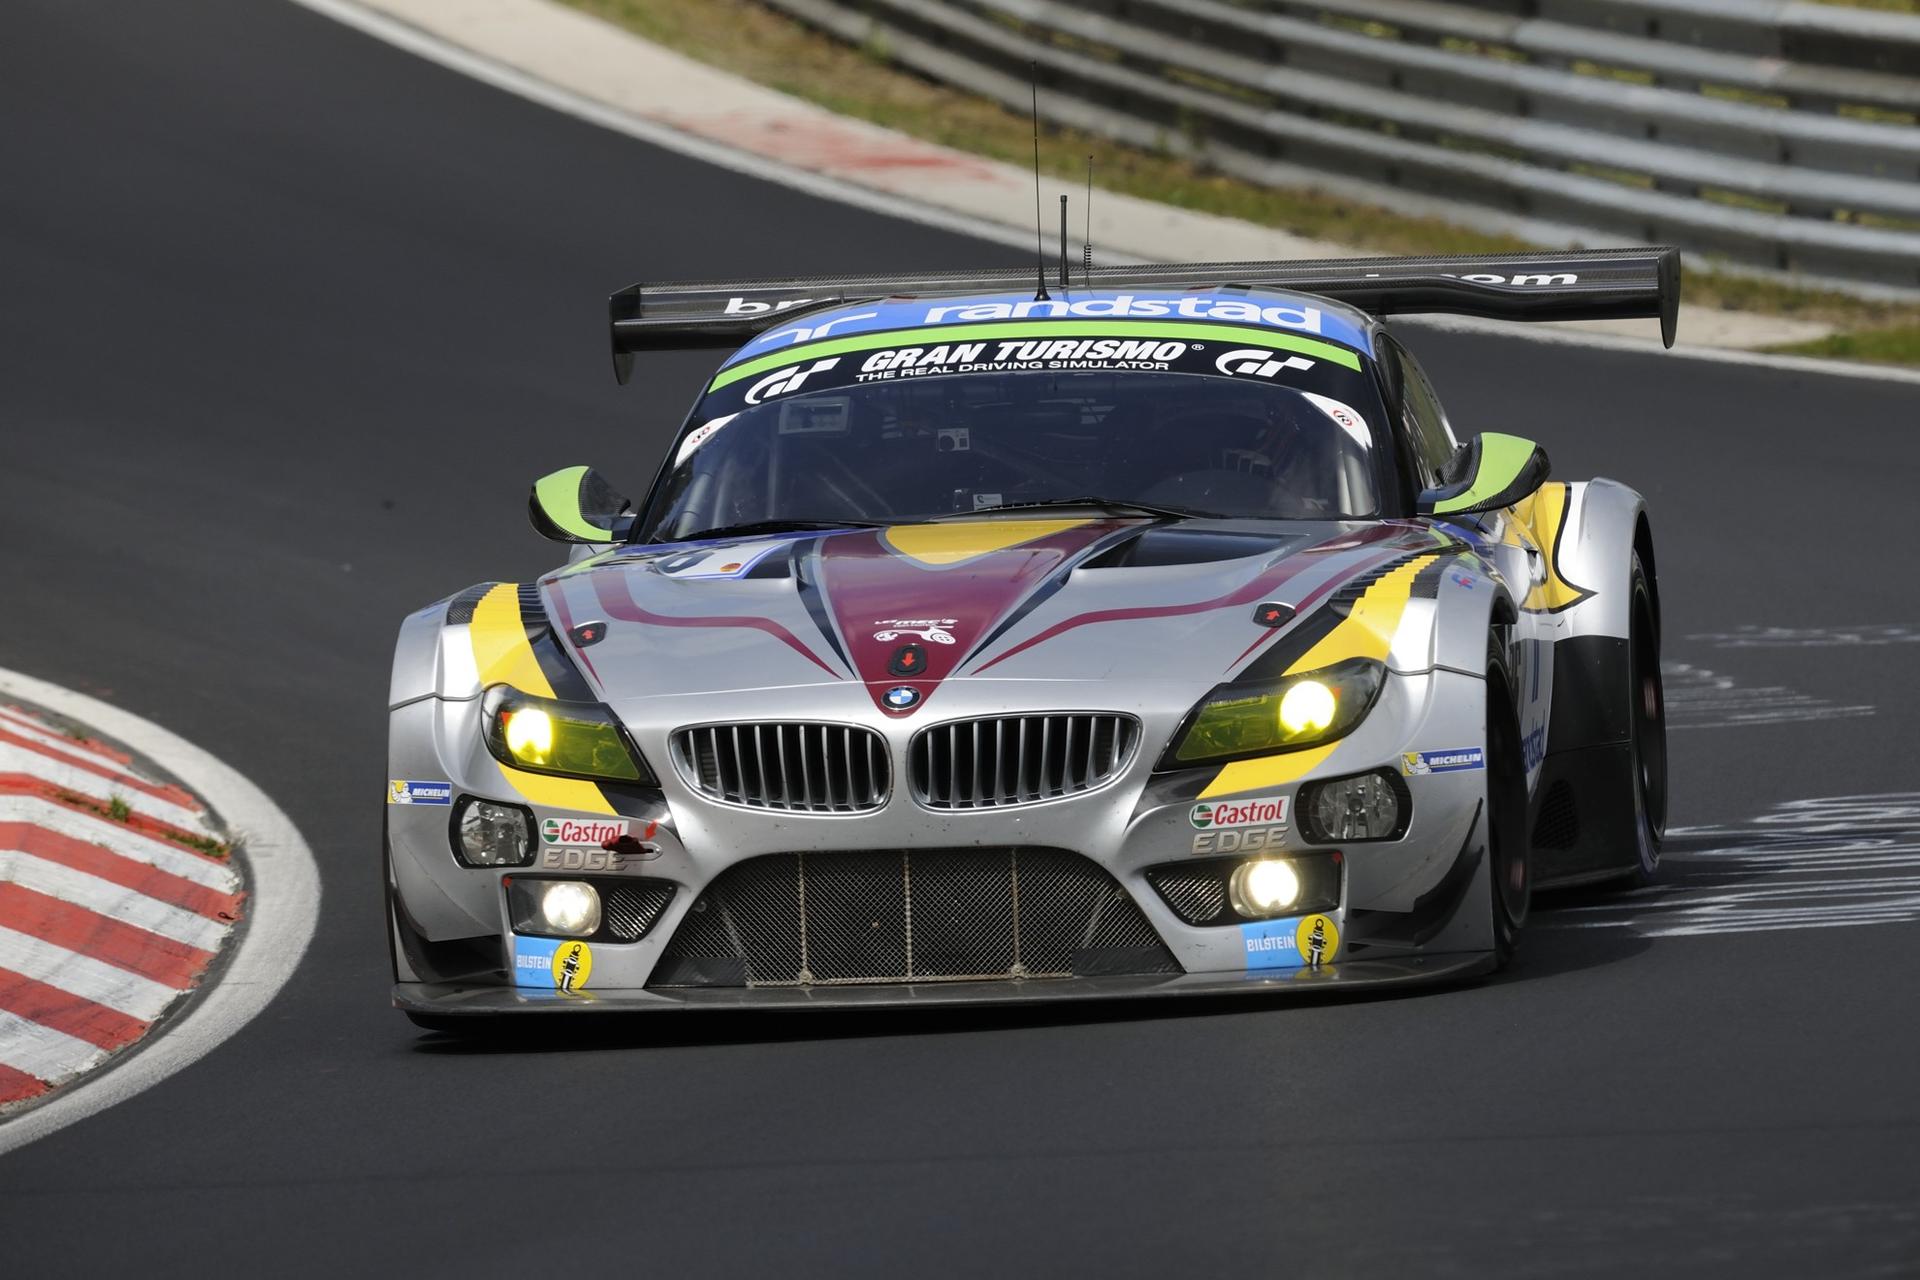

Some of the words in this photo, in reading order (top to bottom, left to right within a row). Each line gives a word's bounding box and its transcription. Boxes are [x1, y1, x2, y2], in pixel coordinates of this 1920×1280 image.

[924, 295, 1322, 334] randstad
[860, 343, 987, 373] GRAN
[994, 340, 1187, 361] TURISMO
[856, 370, 896, 382] THE
[900, 365, 954, 377] REAL
[958, 361, 1043, 372] DRIVING
[1048, 360, 1169, 370] SIMULATOR
[1429, 753, 1482, 765] MICHELIN
[412, 788, 450, 797] MICHELIN
[1214, 799, 1285, 825] Castrol
[561, 821, 623, 843] Castrol
[1191, 826, 1289, 855] EDGE
[543, 848, 627, 871] EDGE
[1246, 935, 1297, 952] BILSTEIN
[516, 954, 553, 970] BILSTEIN
